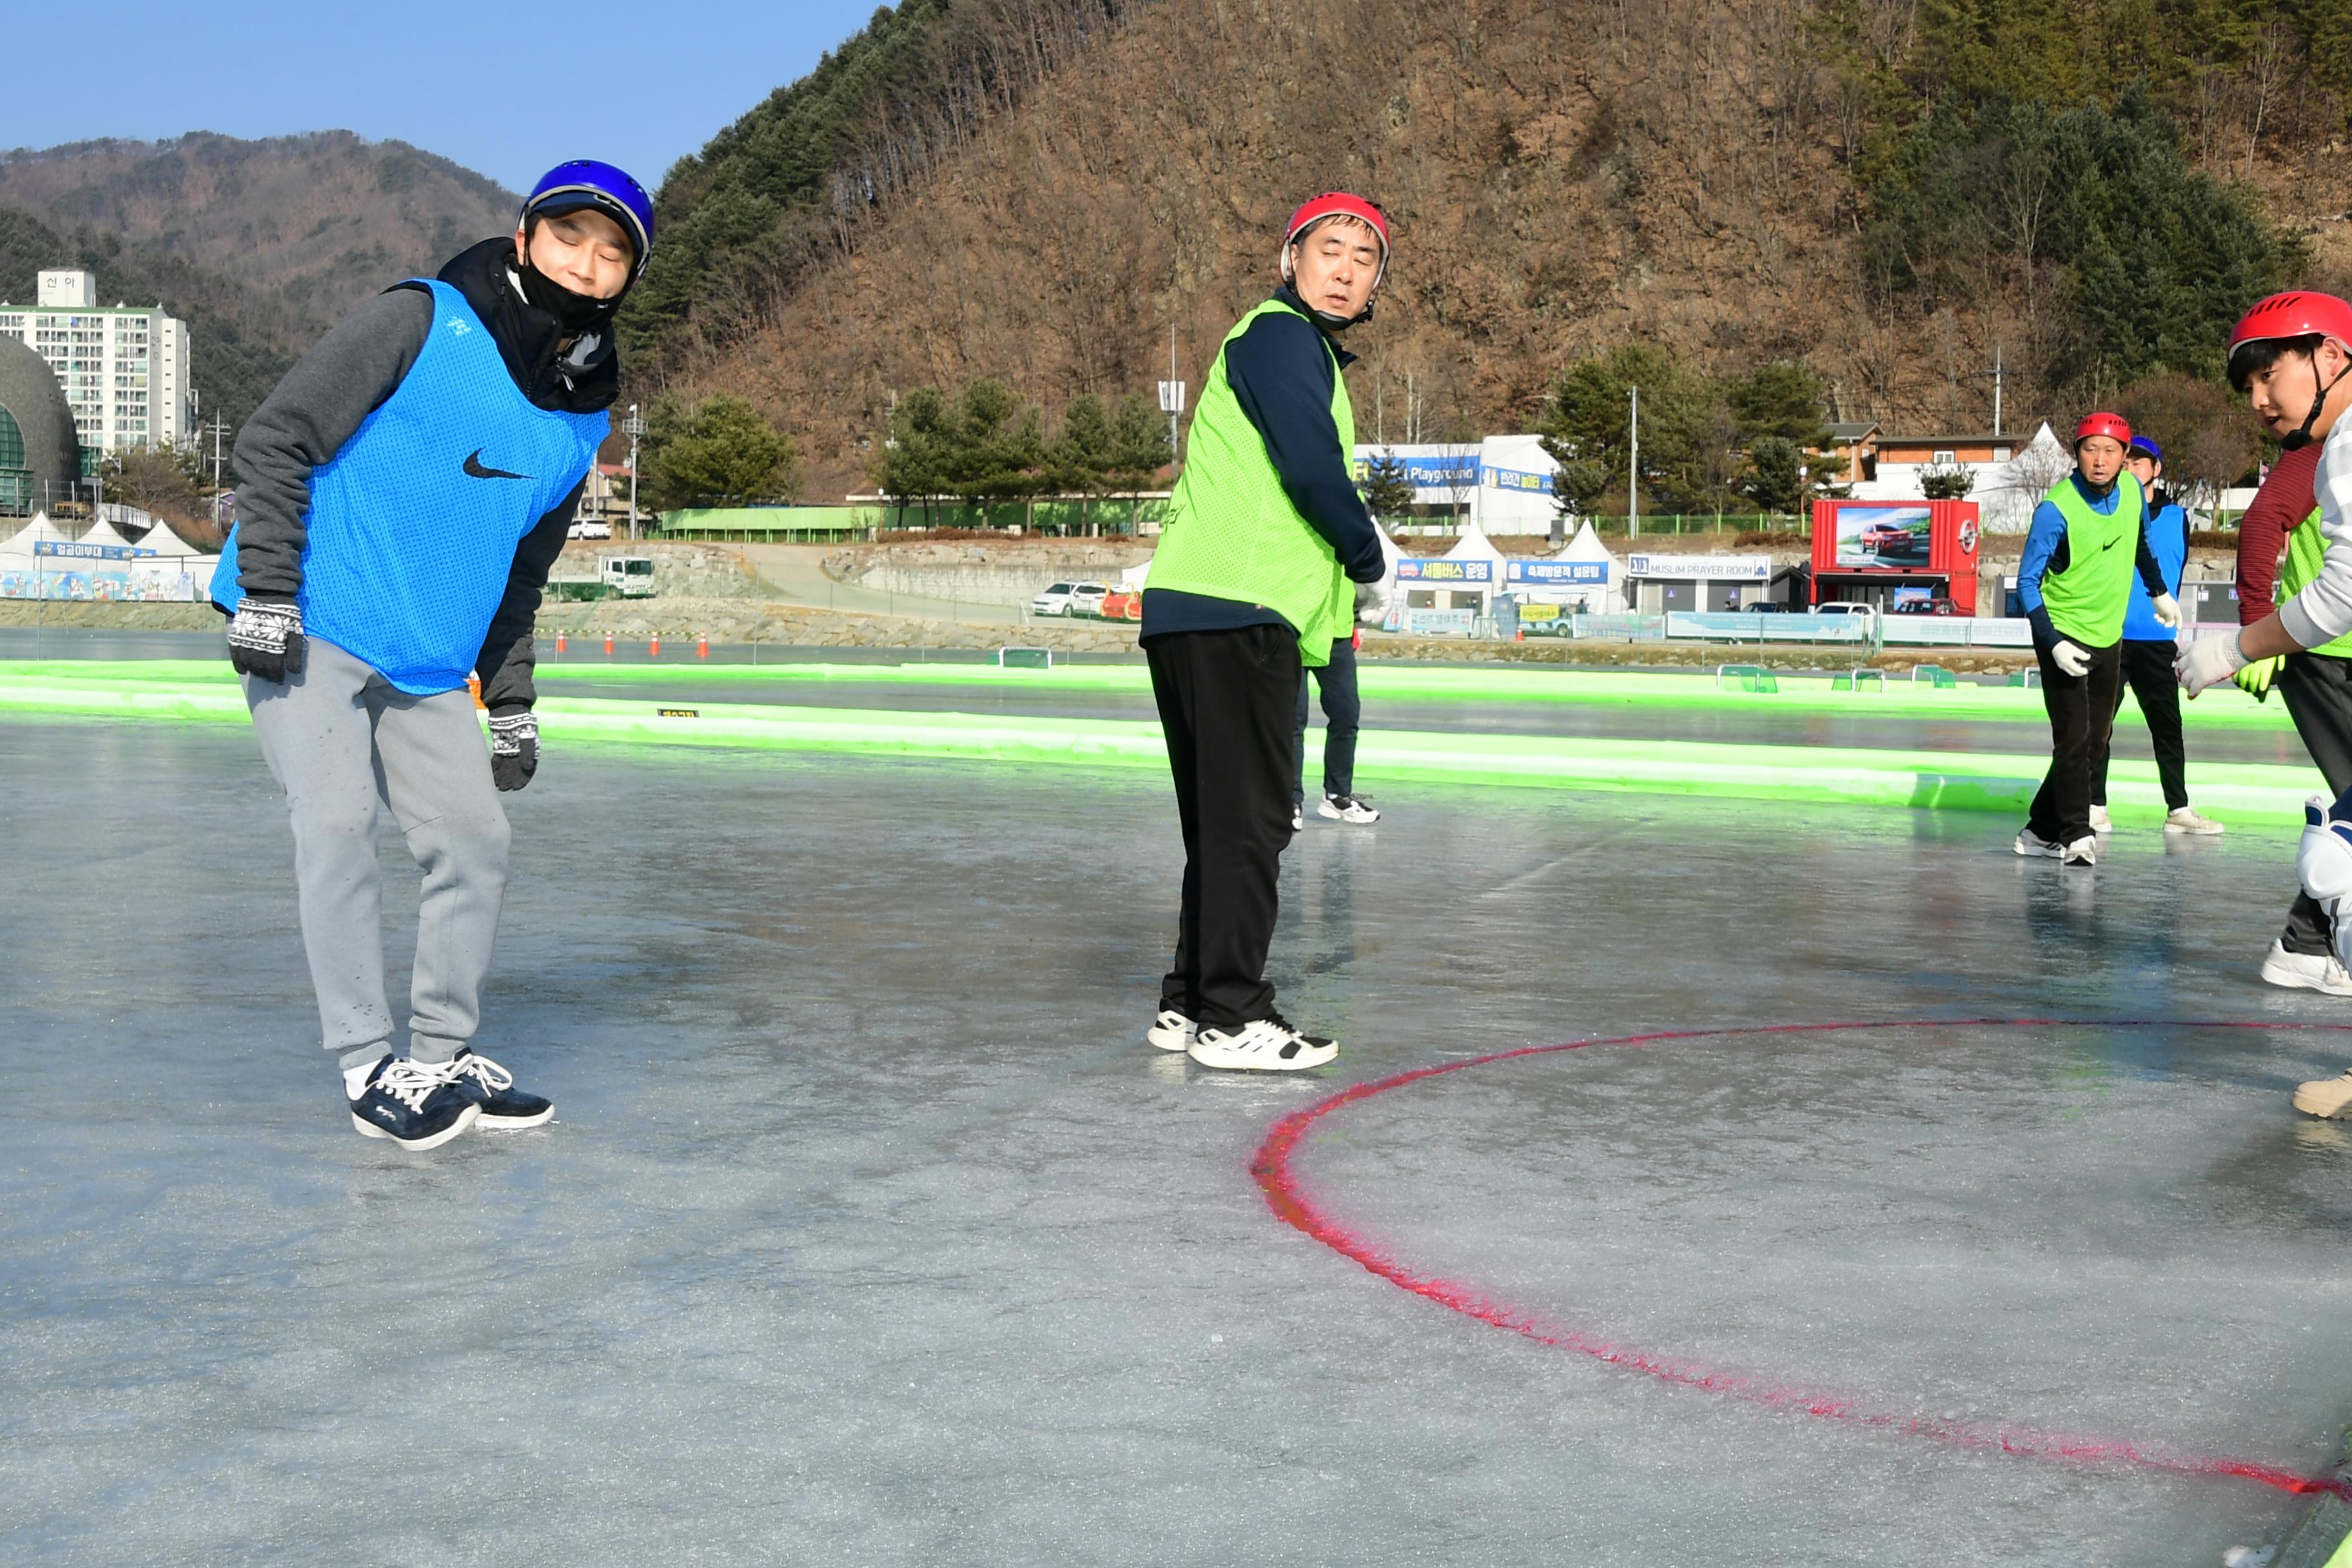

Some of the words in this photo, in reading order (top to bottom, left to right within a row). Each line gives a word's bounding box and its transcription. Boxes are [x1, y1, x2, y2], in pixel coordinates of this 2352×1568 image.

[1411, 466, 1473, 483] Playground
[1421, 562, 1464, 579] 셔틀버스
[1465, 562, 1487, 579] 운영
[1651, 564, 1685, 574] MUSLIM
[1687, 565, 1723, 575] PRAYER
[1726, 565, 1752, 575] ROOM
